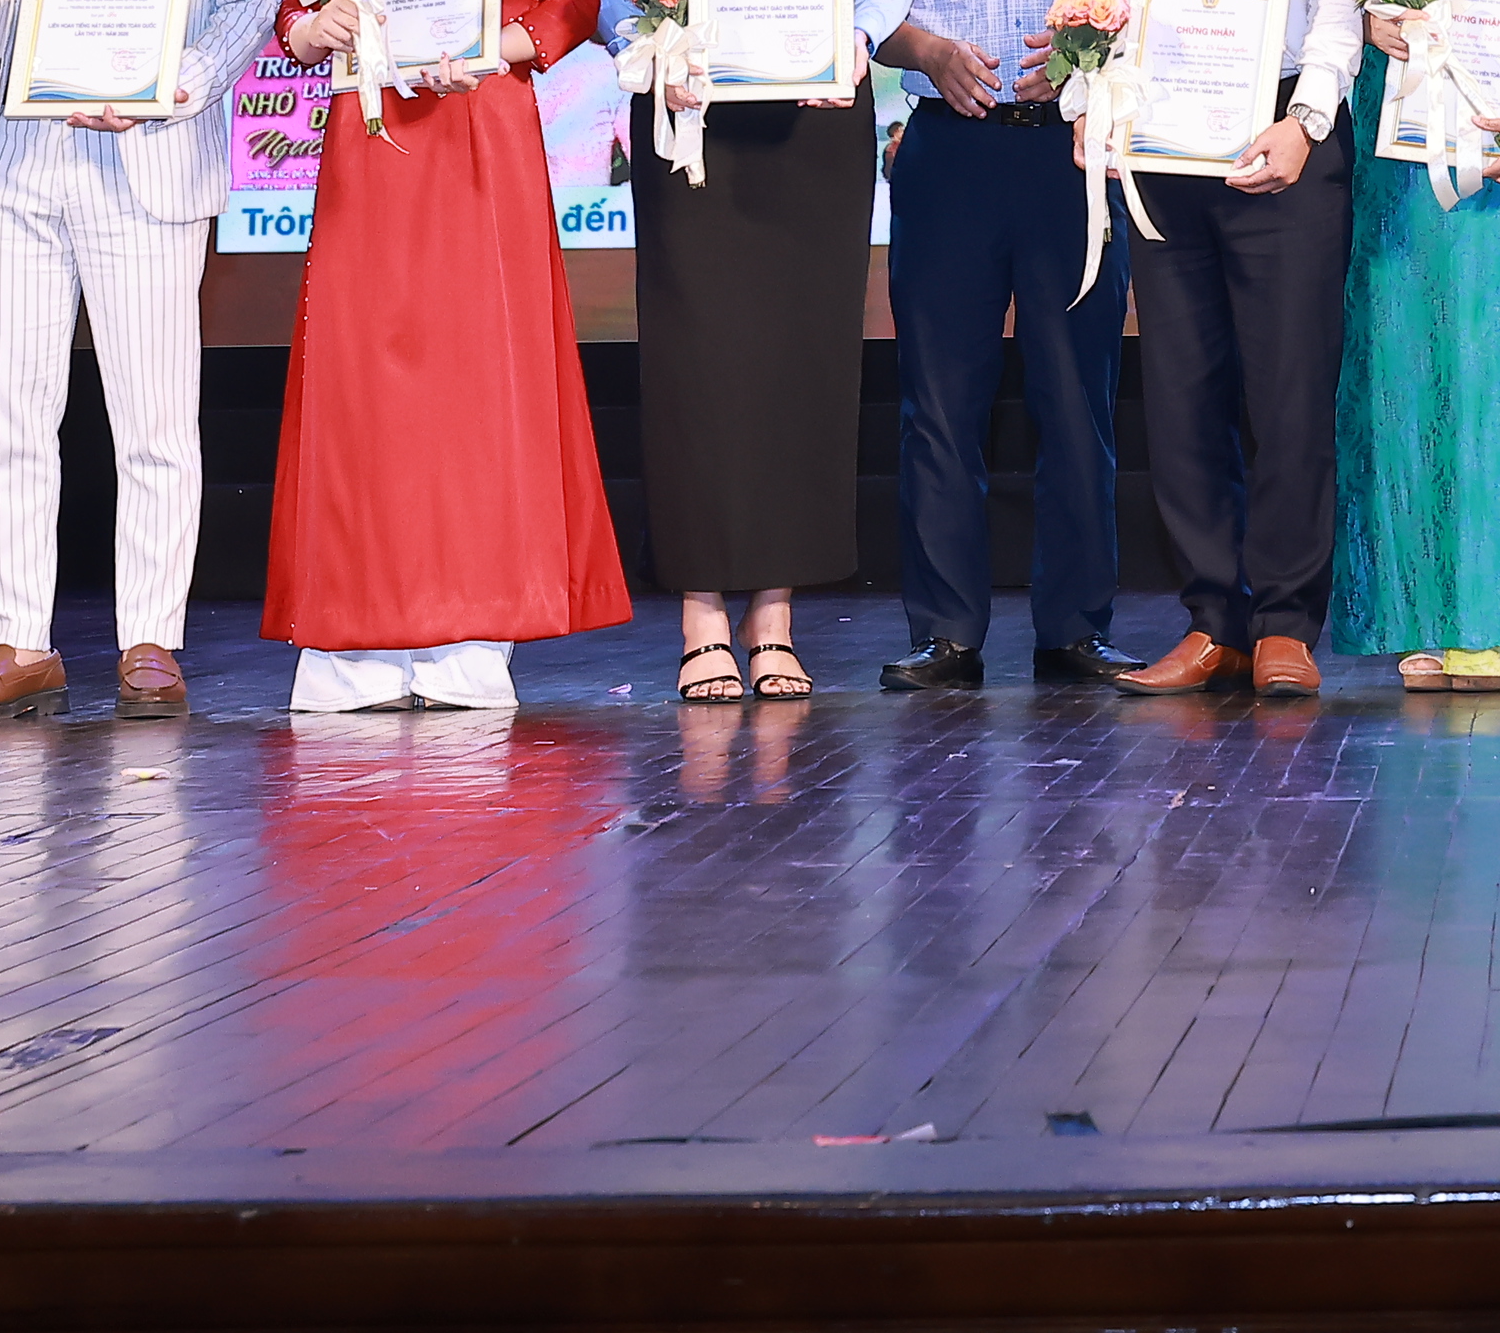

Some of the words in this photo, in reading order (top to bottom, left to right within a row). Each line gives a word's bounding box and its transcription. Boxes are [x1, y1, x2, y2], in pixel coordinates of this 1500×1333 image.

[1451, 14, 1477, 24] HỨNG
[1176, 25, 1209, 36] CHỨNG
[1211, 27, 1236, 39] NHẬN
[237, 85, 296, 117] NHỚ
[242, 207, 312, 236] Trôn
[561, 197, 627, 233] đến
